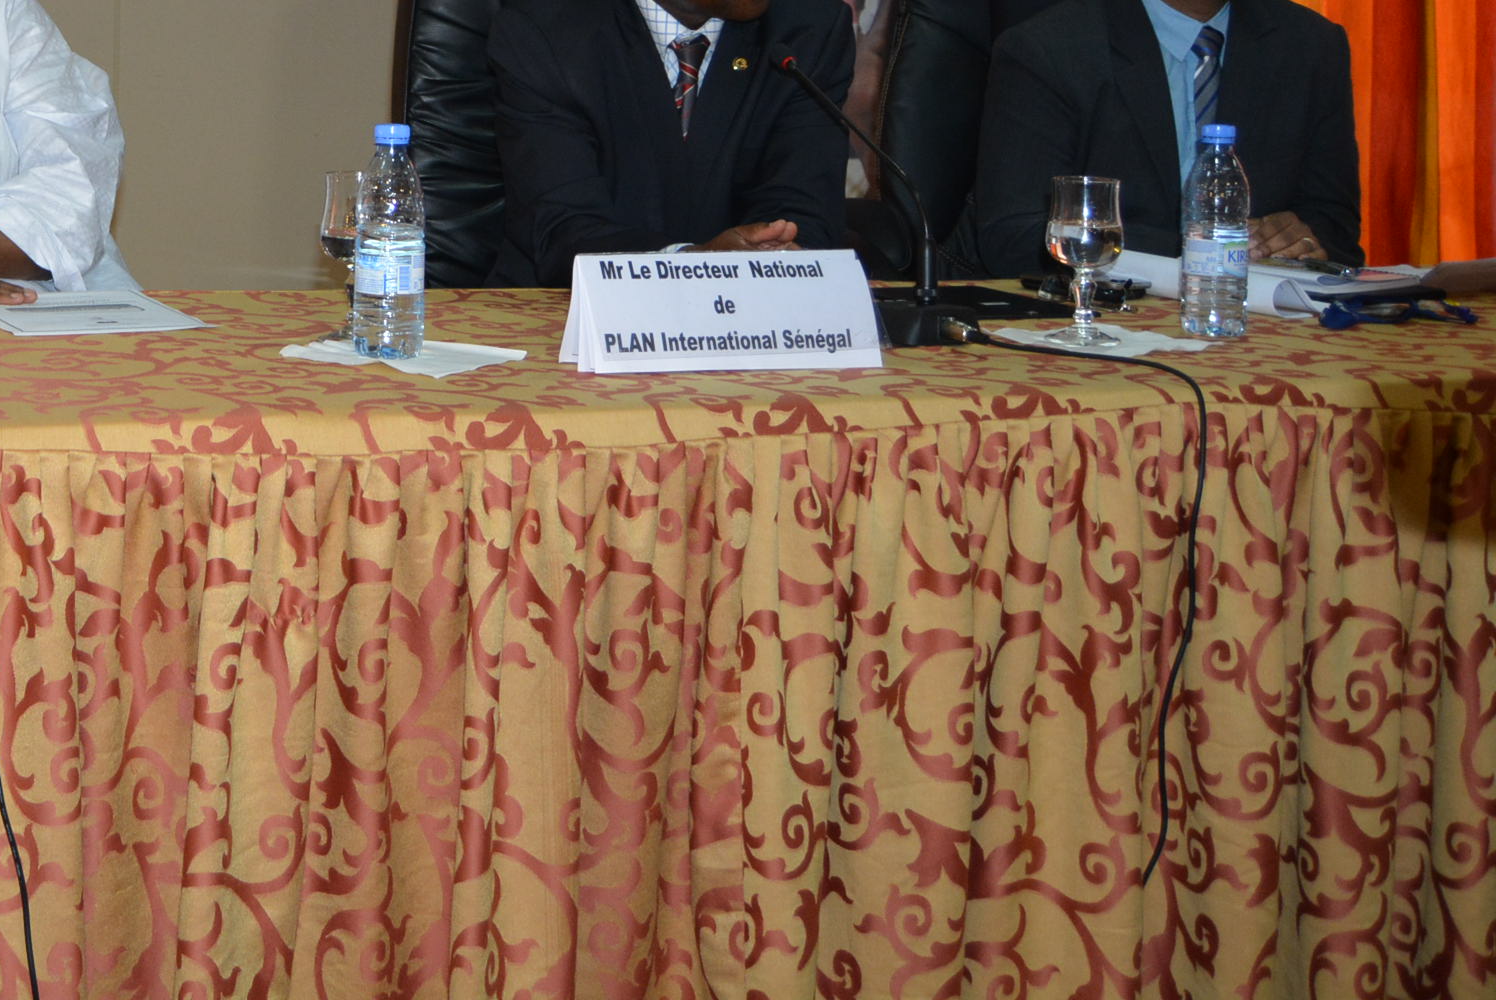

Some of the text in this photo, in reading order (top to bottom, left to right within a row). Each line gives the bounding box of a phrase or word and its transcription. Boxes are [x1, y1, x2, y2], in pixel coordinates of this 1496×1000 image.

[599, 259, 824, 280] Mr Le Directeur National
[713, 295, 736, 314] de
[604, 328, 853, 354] PLAN International Sénégal
